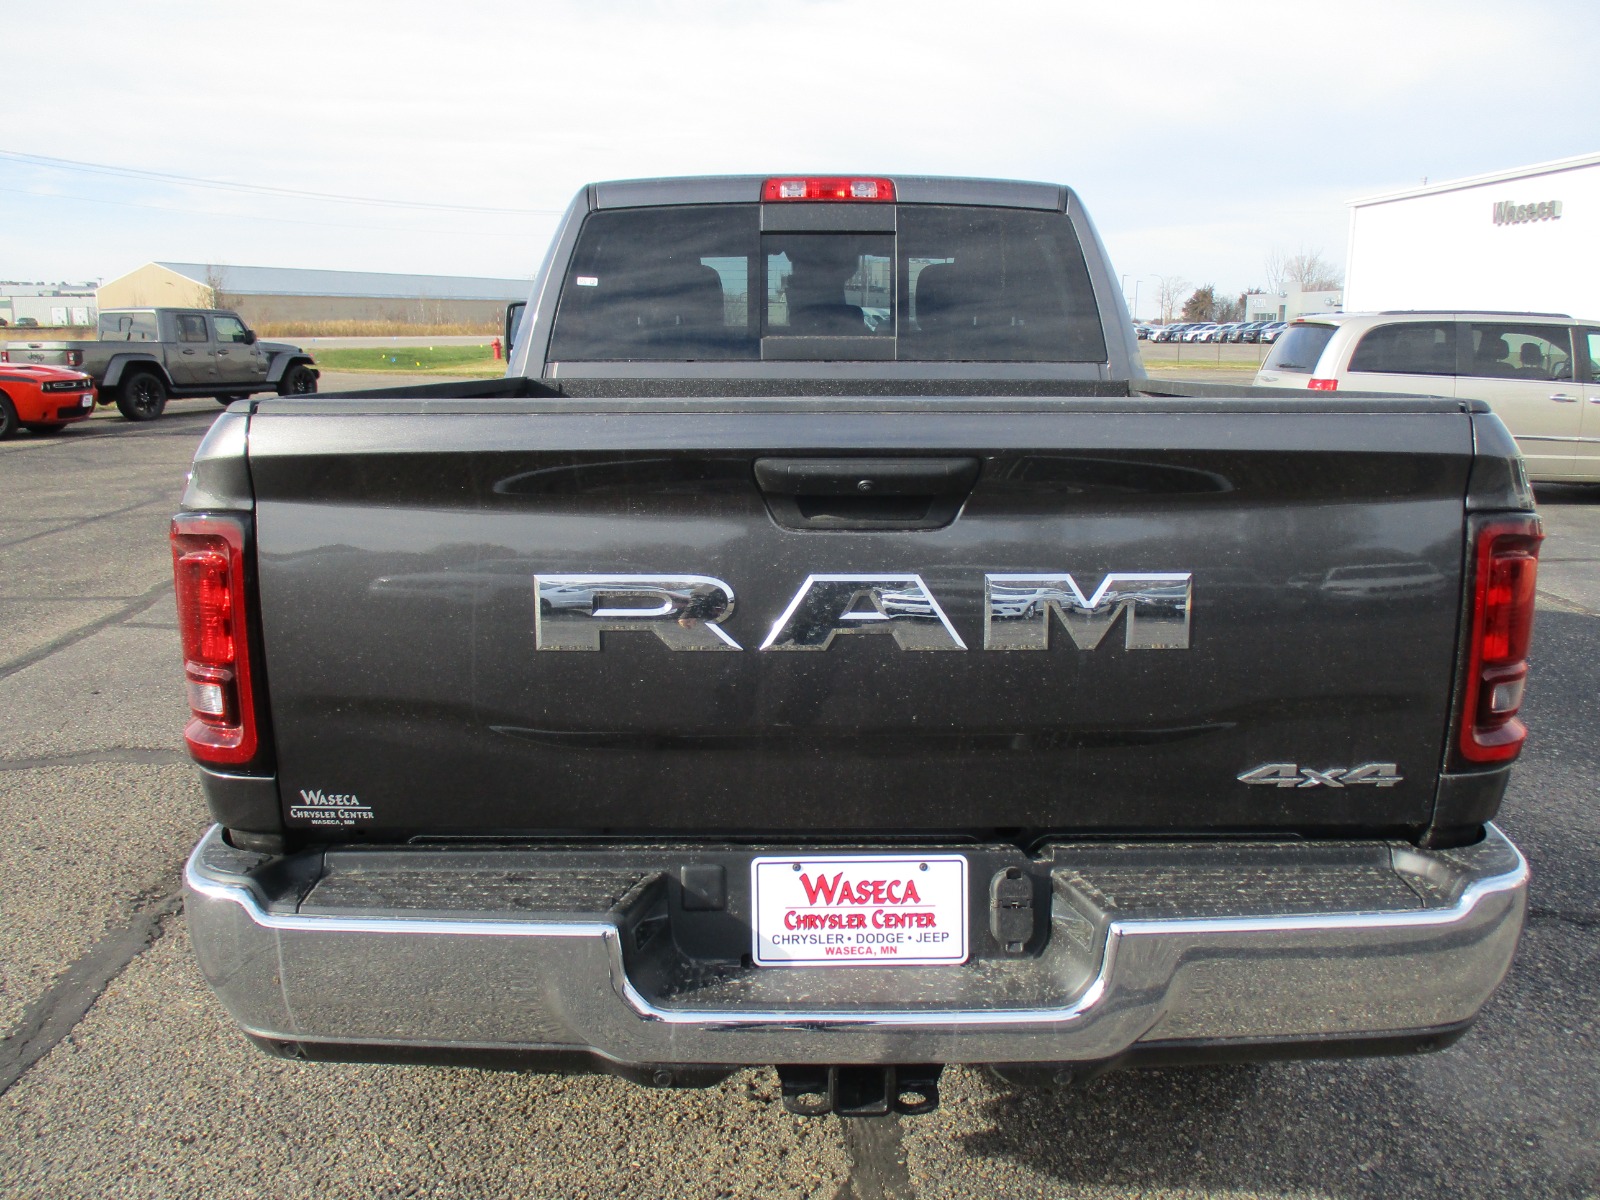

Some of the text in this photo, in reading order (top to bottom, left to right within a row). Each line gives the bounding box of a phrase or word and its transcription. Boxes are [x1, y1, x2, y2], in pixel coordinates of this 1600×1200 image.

[534, 573, 1192, 651] RAM
[772, 932, 950, 945] CHRYSLER DODGE JEEP
[880, 945, 898, 955] MN
